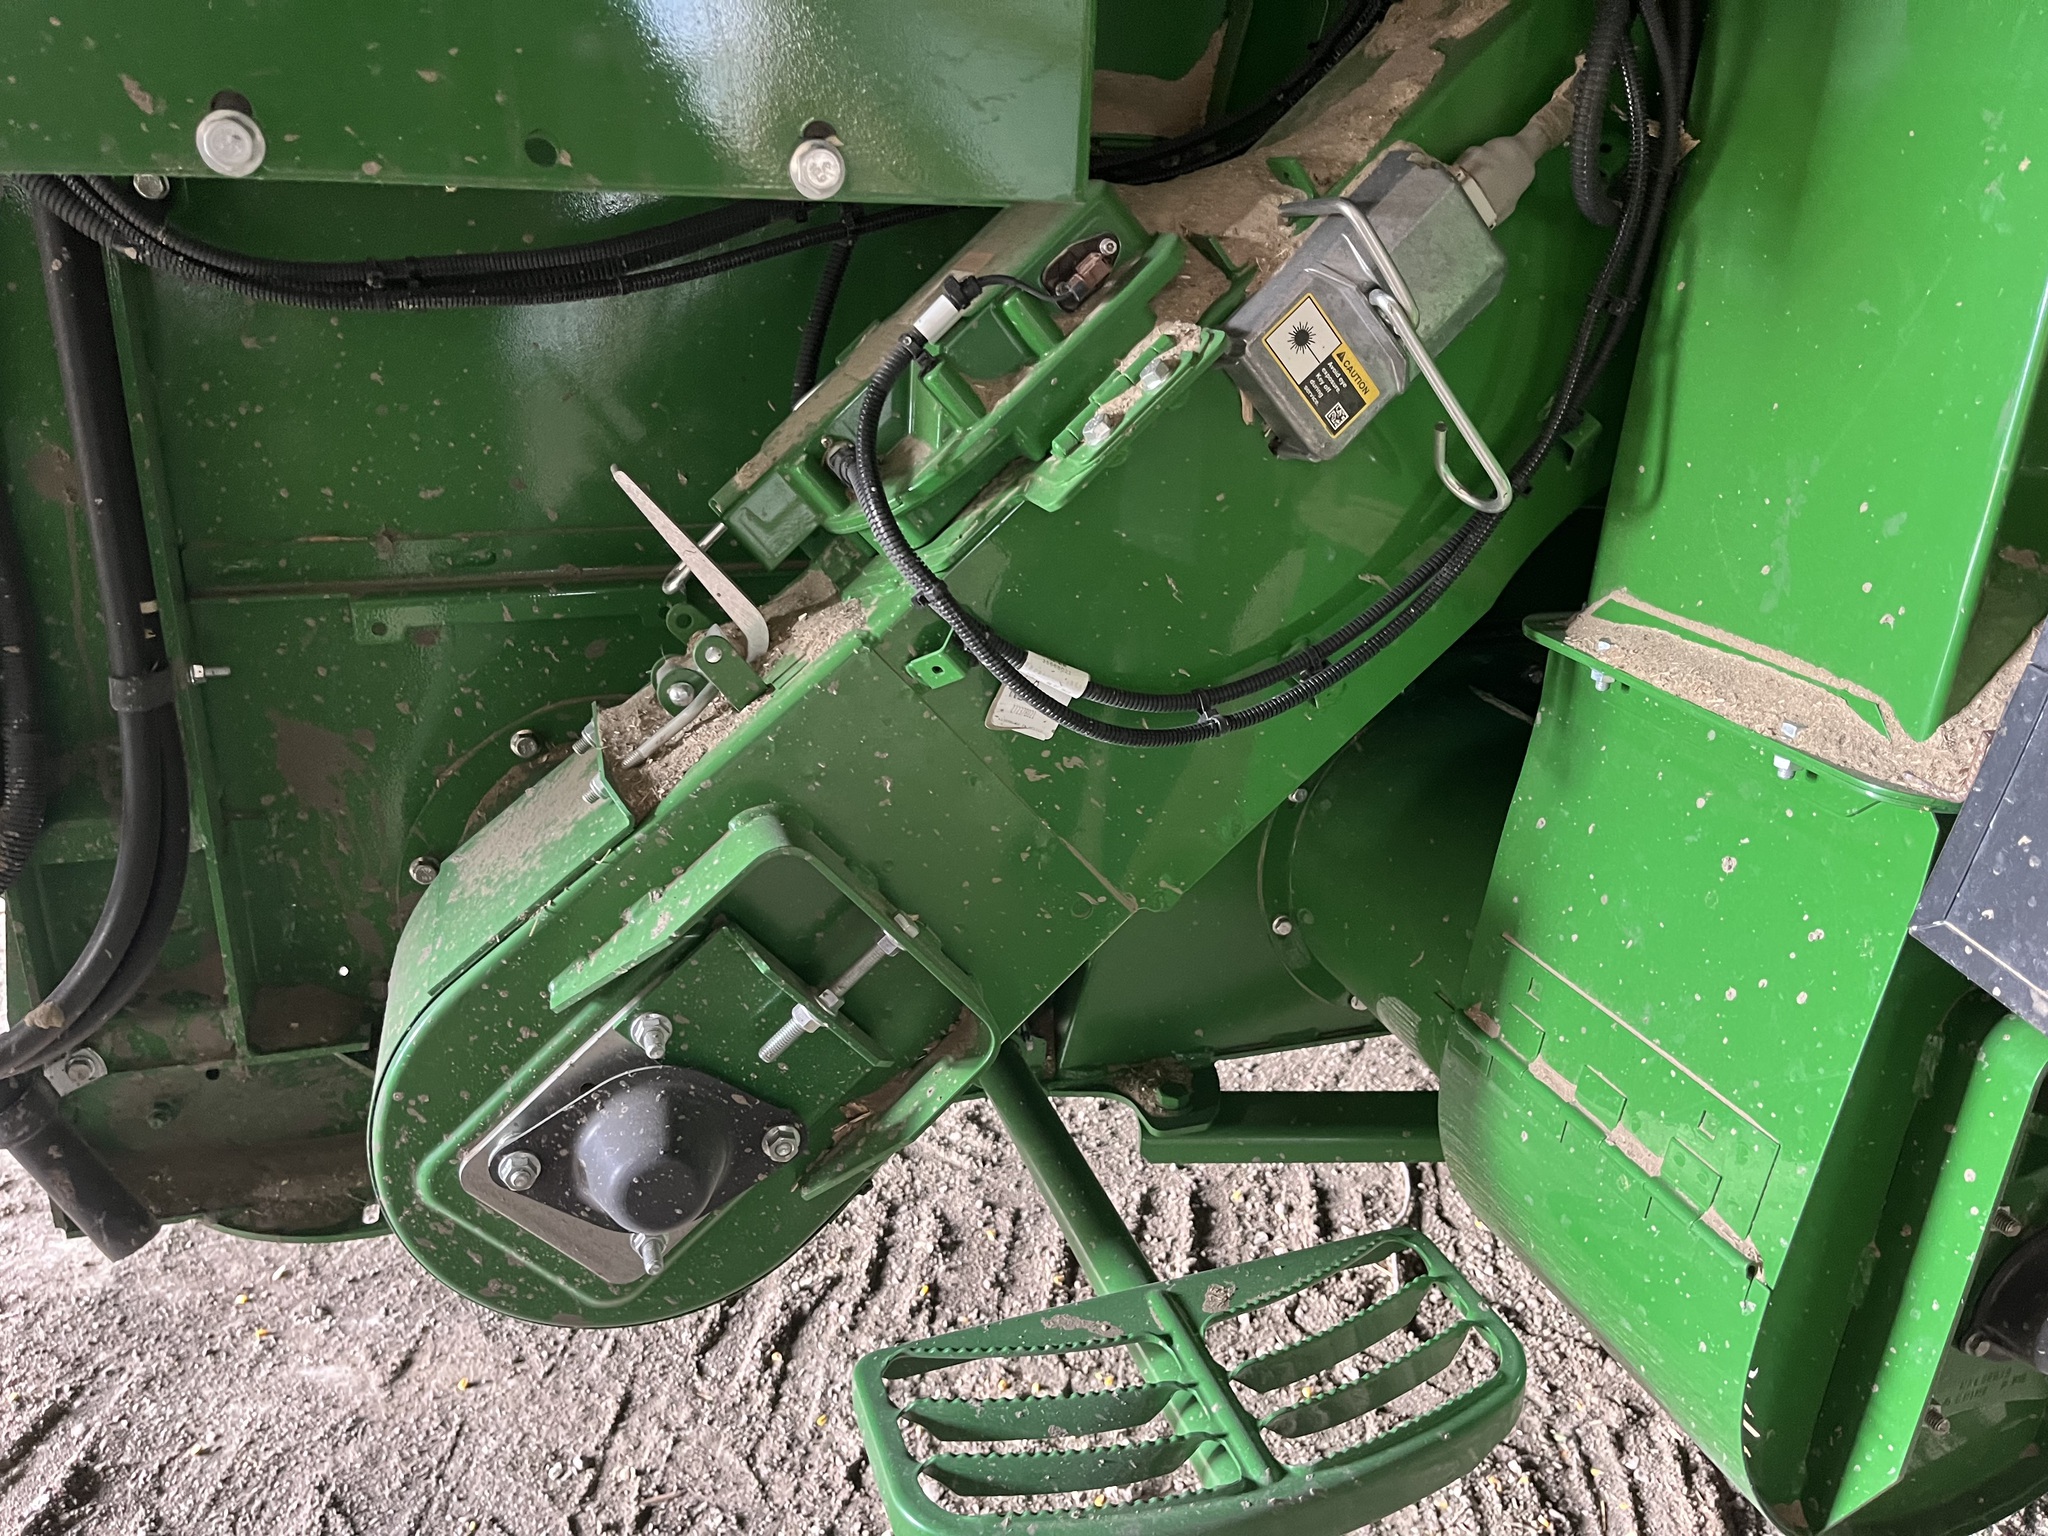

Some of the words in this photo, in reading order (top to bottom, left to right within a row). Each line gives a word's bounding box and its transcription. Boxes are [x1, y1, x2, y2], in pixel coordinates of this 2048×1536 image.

[1315, 372, 1325, 385] Key
[1323, 384, 1332, 393] off
[1321, 367, 1341, 394] exposure.
[1327, 361, 1341, 378] Avoid
[1338, 377, 1347, 388] eye
[1343, 360, 1370, 395] CAUTION
[1303, 385, 1319, 407] service.
[1309, 379, 1324, 399] during
